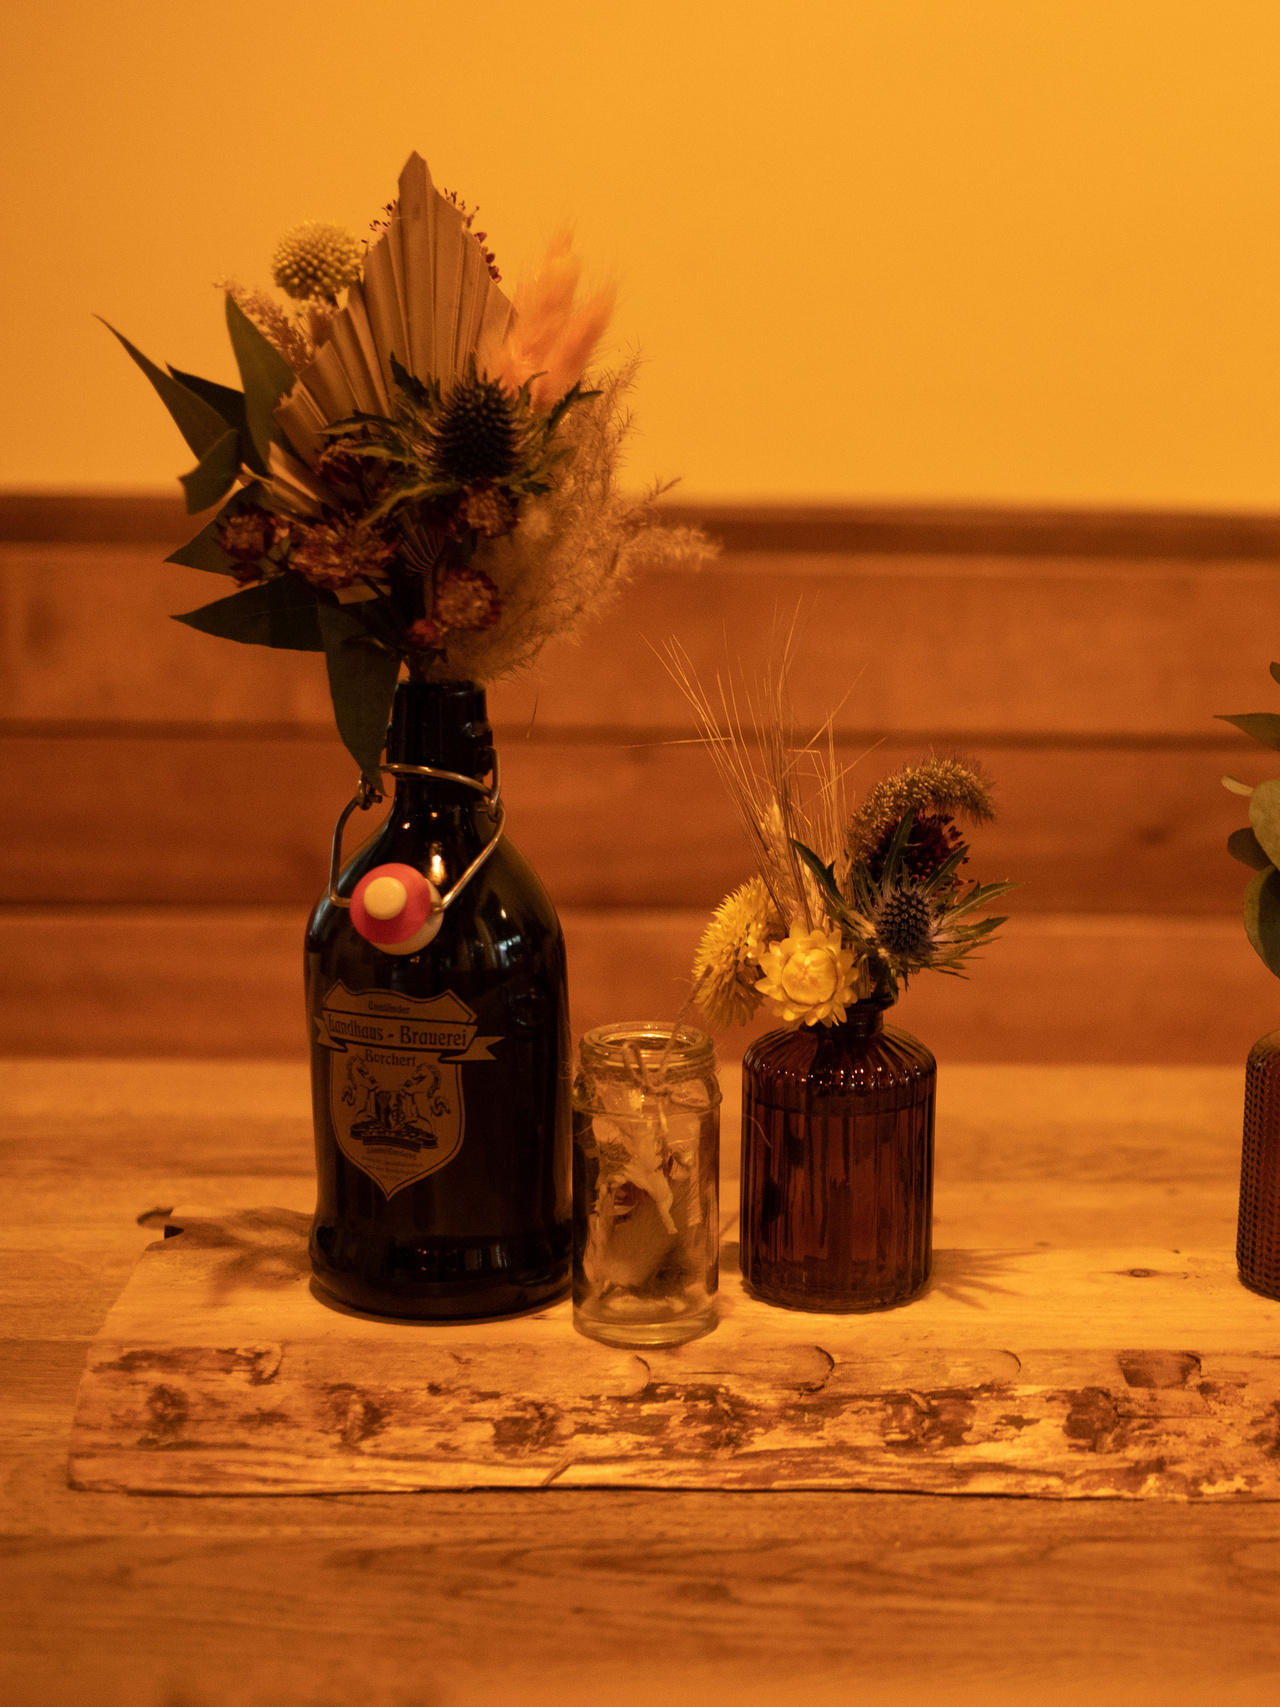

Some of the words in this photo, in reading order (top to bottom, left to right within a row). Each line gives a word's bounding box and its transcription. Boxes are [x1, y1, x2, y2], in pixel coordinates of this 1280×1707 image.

[329, 1013, 383, 1041] Landhaus
[400, 1025, 466, 1046] Brauerei
[364, 1048, 417, 1066] Borchert
